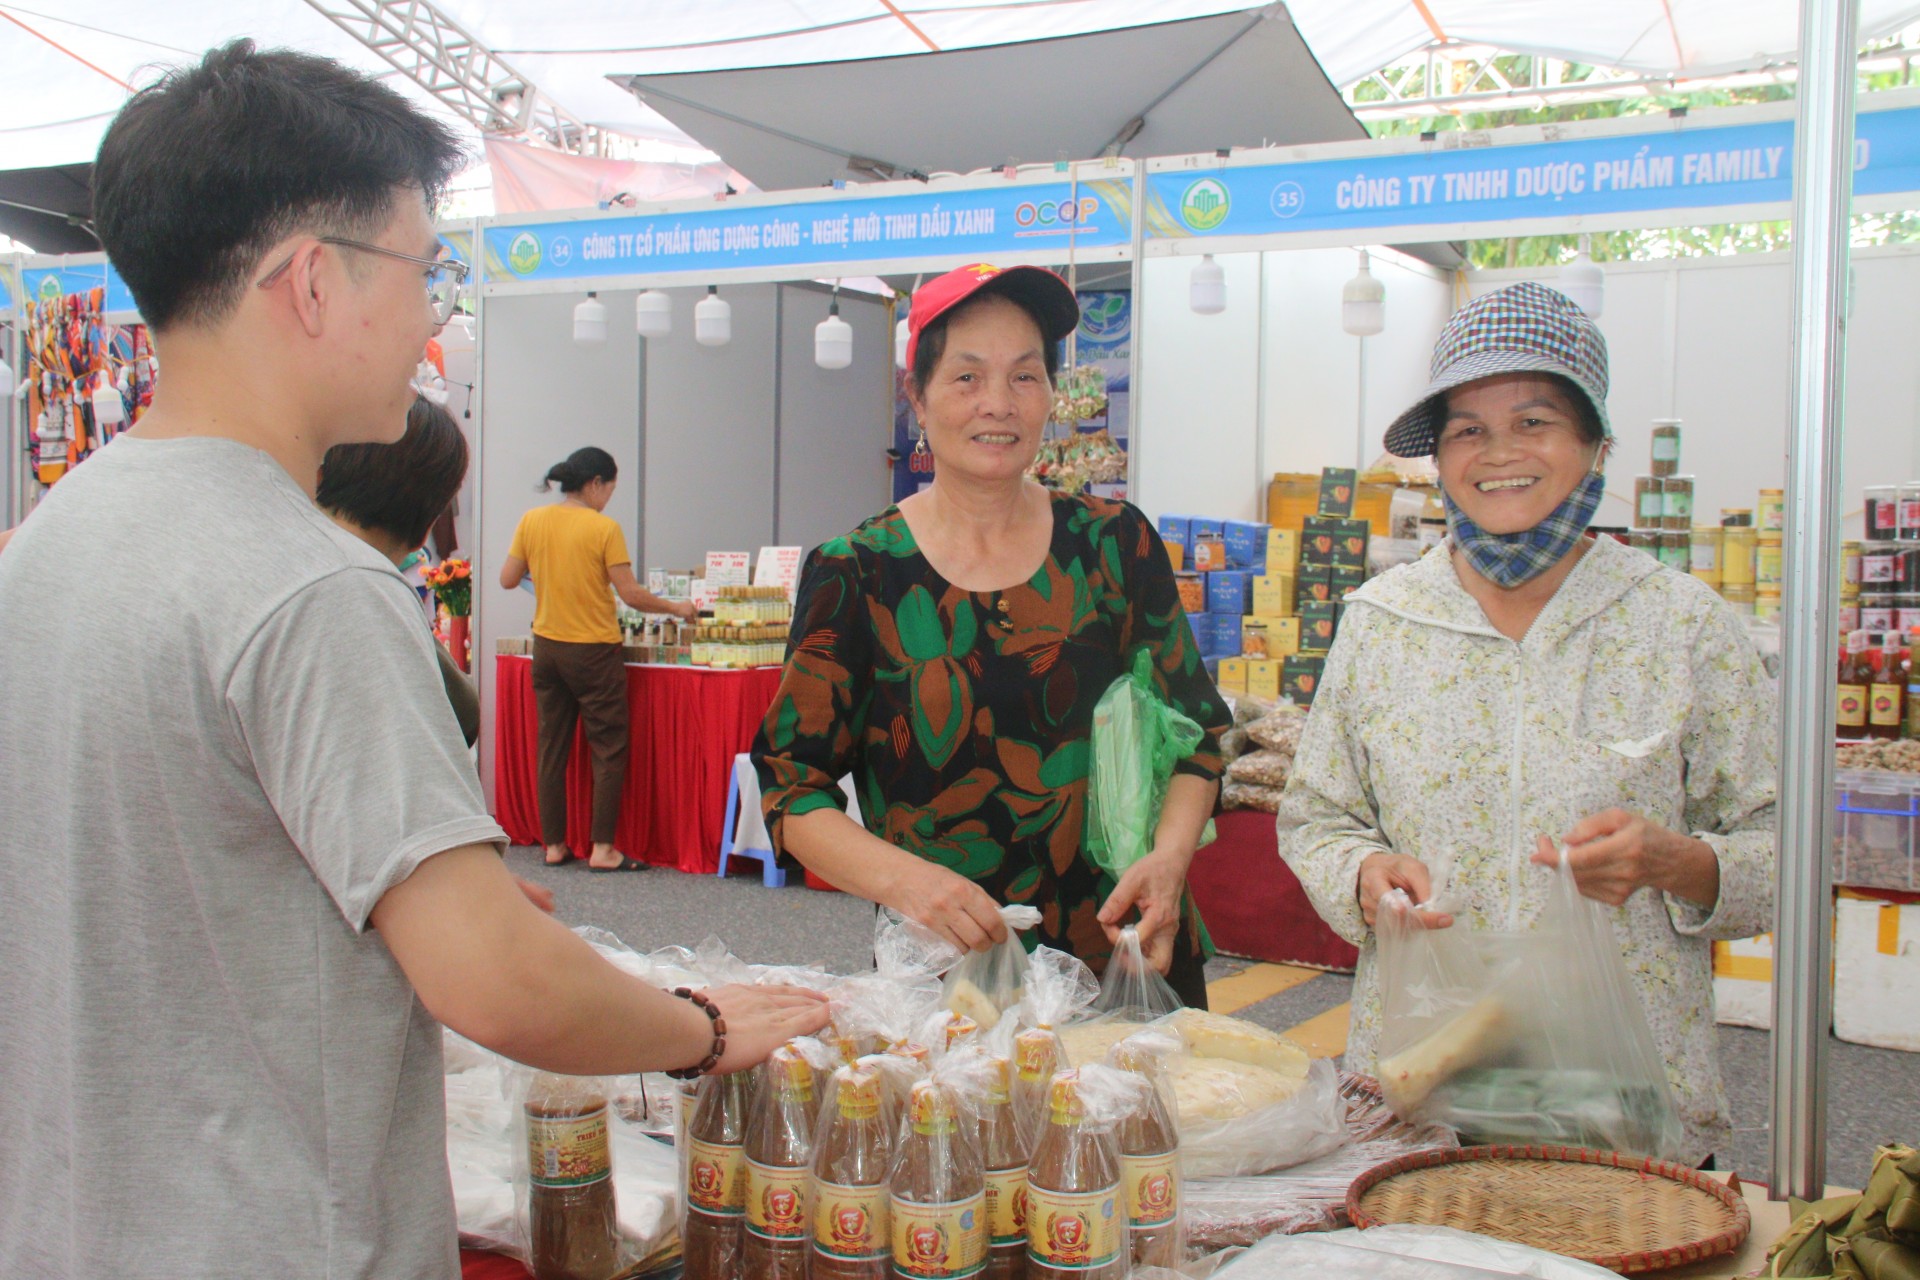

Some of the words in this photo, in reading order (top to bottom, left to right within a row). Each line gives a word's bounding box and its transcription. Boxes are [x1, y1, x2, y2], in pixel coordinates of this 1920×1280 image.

[1336, 174, 1400, 210] CÔNG
[1408, 175, 1437, 204] TY
[1442, 168, 1508, 203] TNHH
[1515, 159, 1586, 201] DƯỢC
[1593, 145, 1674, 191] PHẨM
[1681, 145, 1785, 185] FAMILY
[1014, 196, 1099, 228] OCOP
[1278, 191, 1298, 207] 35
[582, 232, 616, 260] CÔNG
[618, 233, 634, 258] TY
[763, 218, 800, 249] CÔNG
[812, 213, 849, 249] NGHỆ
[884, 213, 917, 240] TINH
[953, 207, 995, 236] XANH
[555, 244, 569, 257] 34
